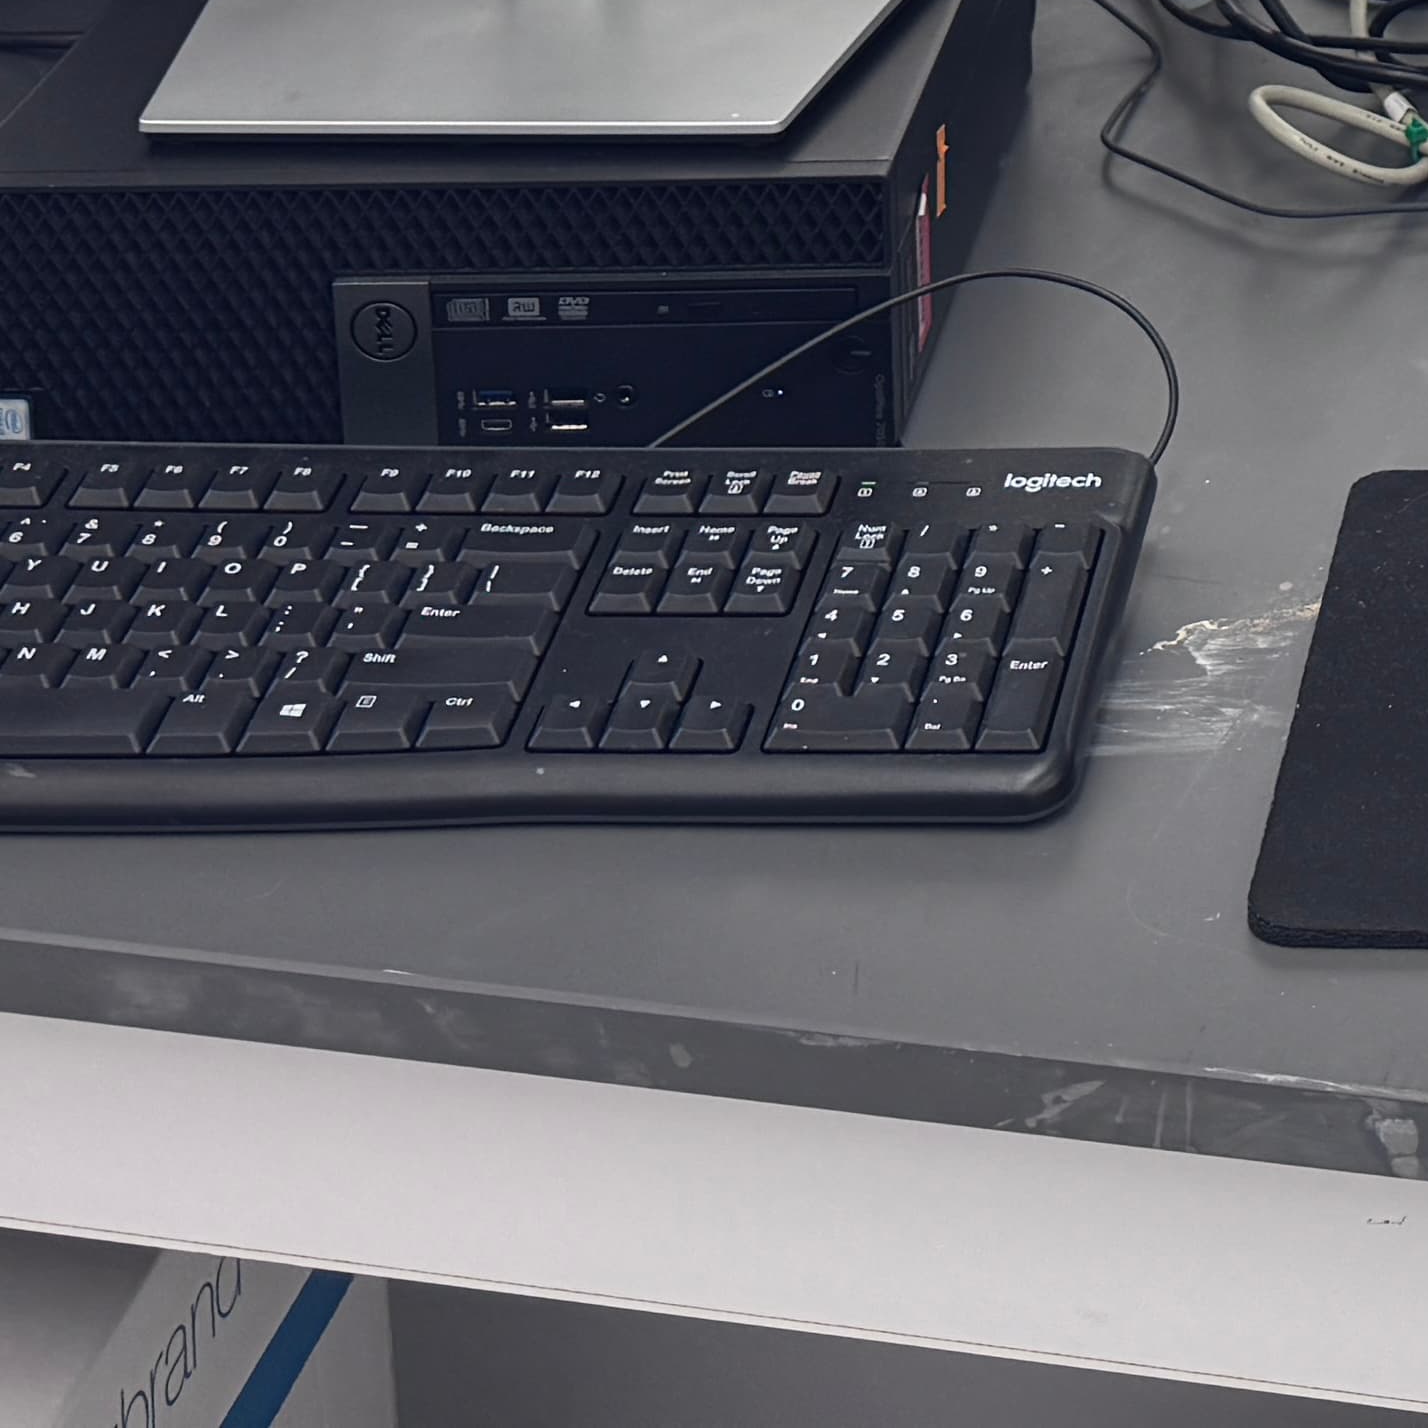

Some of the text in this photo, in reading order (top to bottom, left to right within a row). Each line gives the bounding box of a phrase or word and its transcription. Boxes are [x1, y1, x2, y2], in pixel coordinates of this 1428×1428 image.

[1003, 473, 1102, 493] logitech
[480, 523, 554, 535] Backspace
[632, 524, 670, 534] Insert
[26, 558, 43, 571] Y
[91, 560, 109, 572] U
[156, 561, 168, 574] I
[223, 562, 242, 575] O
[290, 562, 308, 575] P
[612, 566, 654, 577] Delete
[687, 567, 713, 576] End
[12, 602, 31, 615] H
[80, 603, 97, 616] J
[147, 604, 166, 617] K
[215, 605, 228, 617] L
[420, 606, 461, 618] Enter
[17, 647, 37, 660] N
[86, 648, 108, 661] M
[362, 652, 397, 664] Shift
[1009, 659, 1049, 671] Enter
[182, 694, 206, 703] Alt
[445, 696, 473, 707] Ctrl
